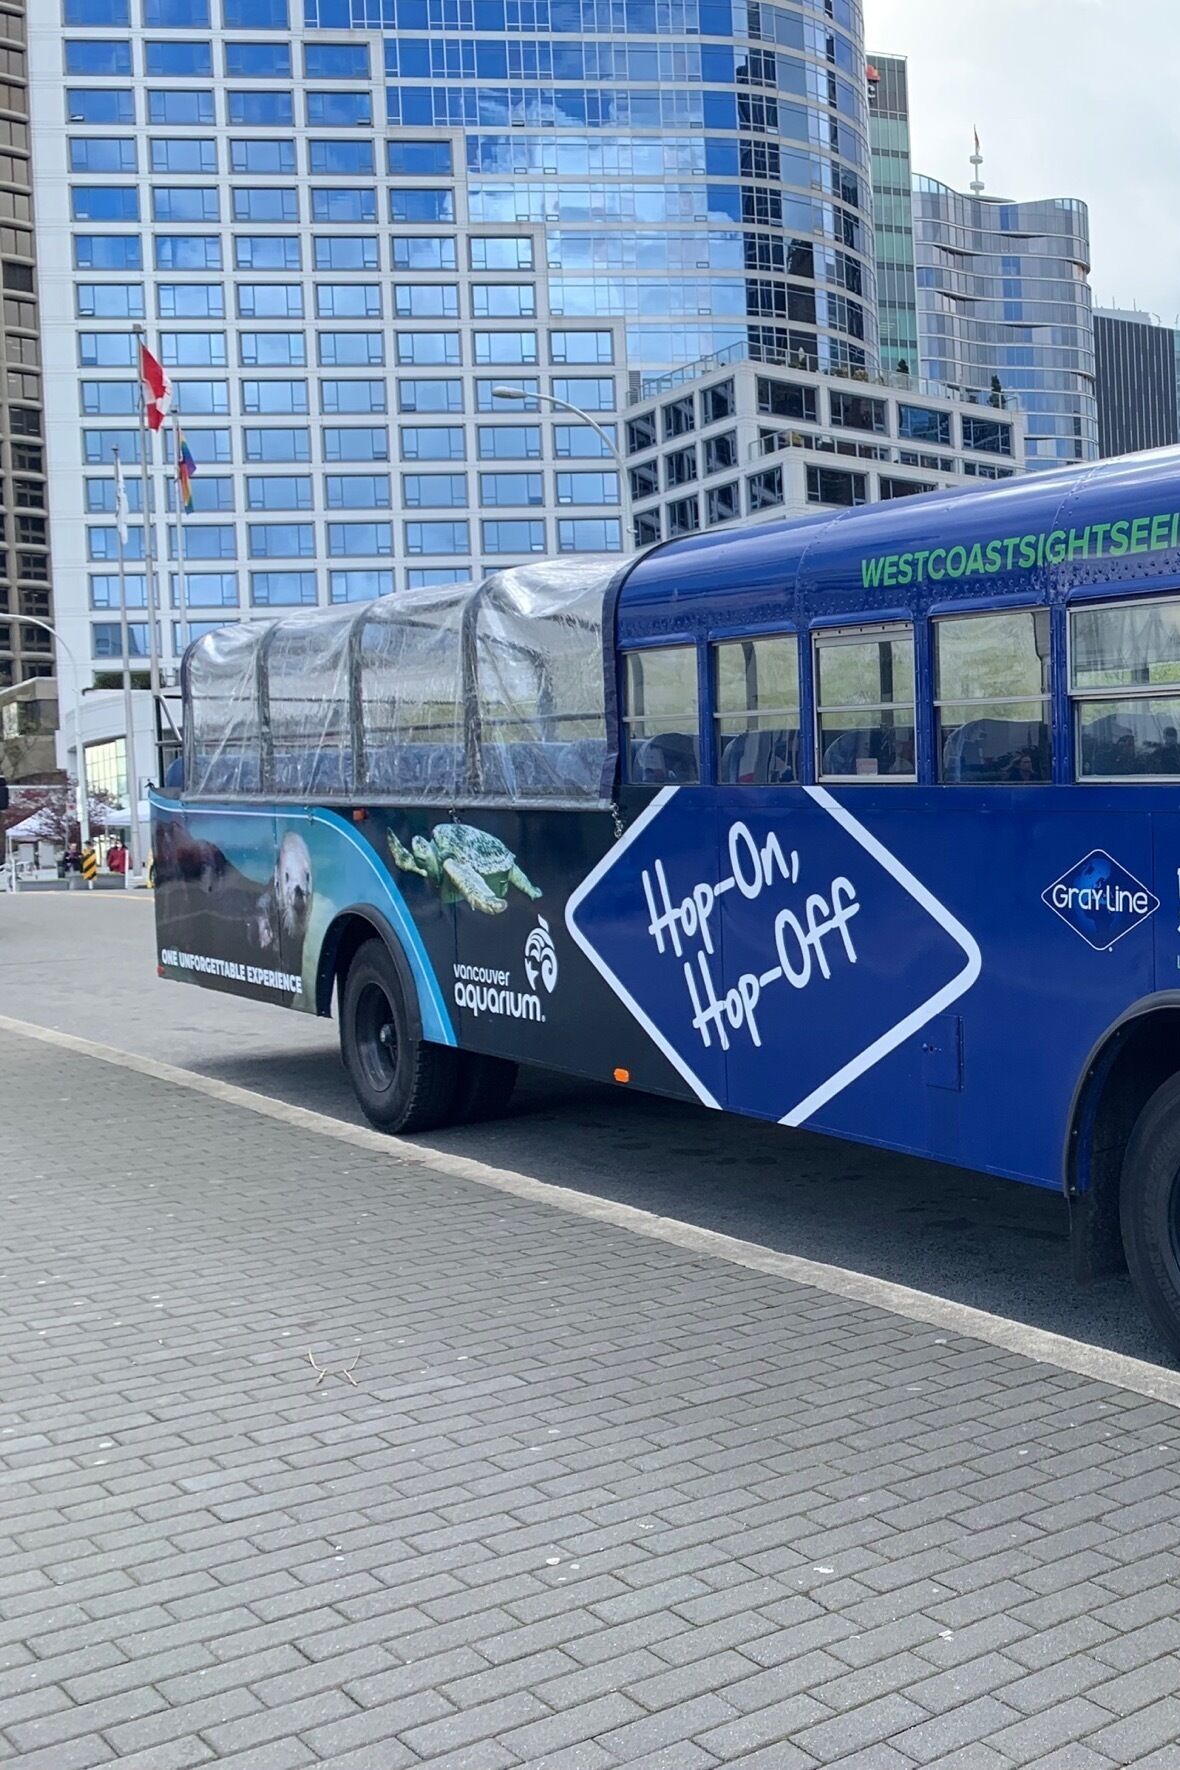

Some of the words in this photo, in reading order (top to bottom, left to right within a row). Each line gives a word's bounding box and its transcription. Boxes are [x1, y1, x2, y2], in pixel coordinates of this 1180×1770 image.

[641, 821, 800, 957] Hop-On,
[161, 949, 179, 966] ONE
[179, 952, 246, 981] UNFORGETTABLE
[246, 965, 303, 994] EXPERIENCE
[453, 963, 510, 986] vancouver
[684, 876, 860, 1050] Hop-Off
